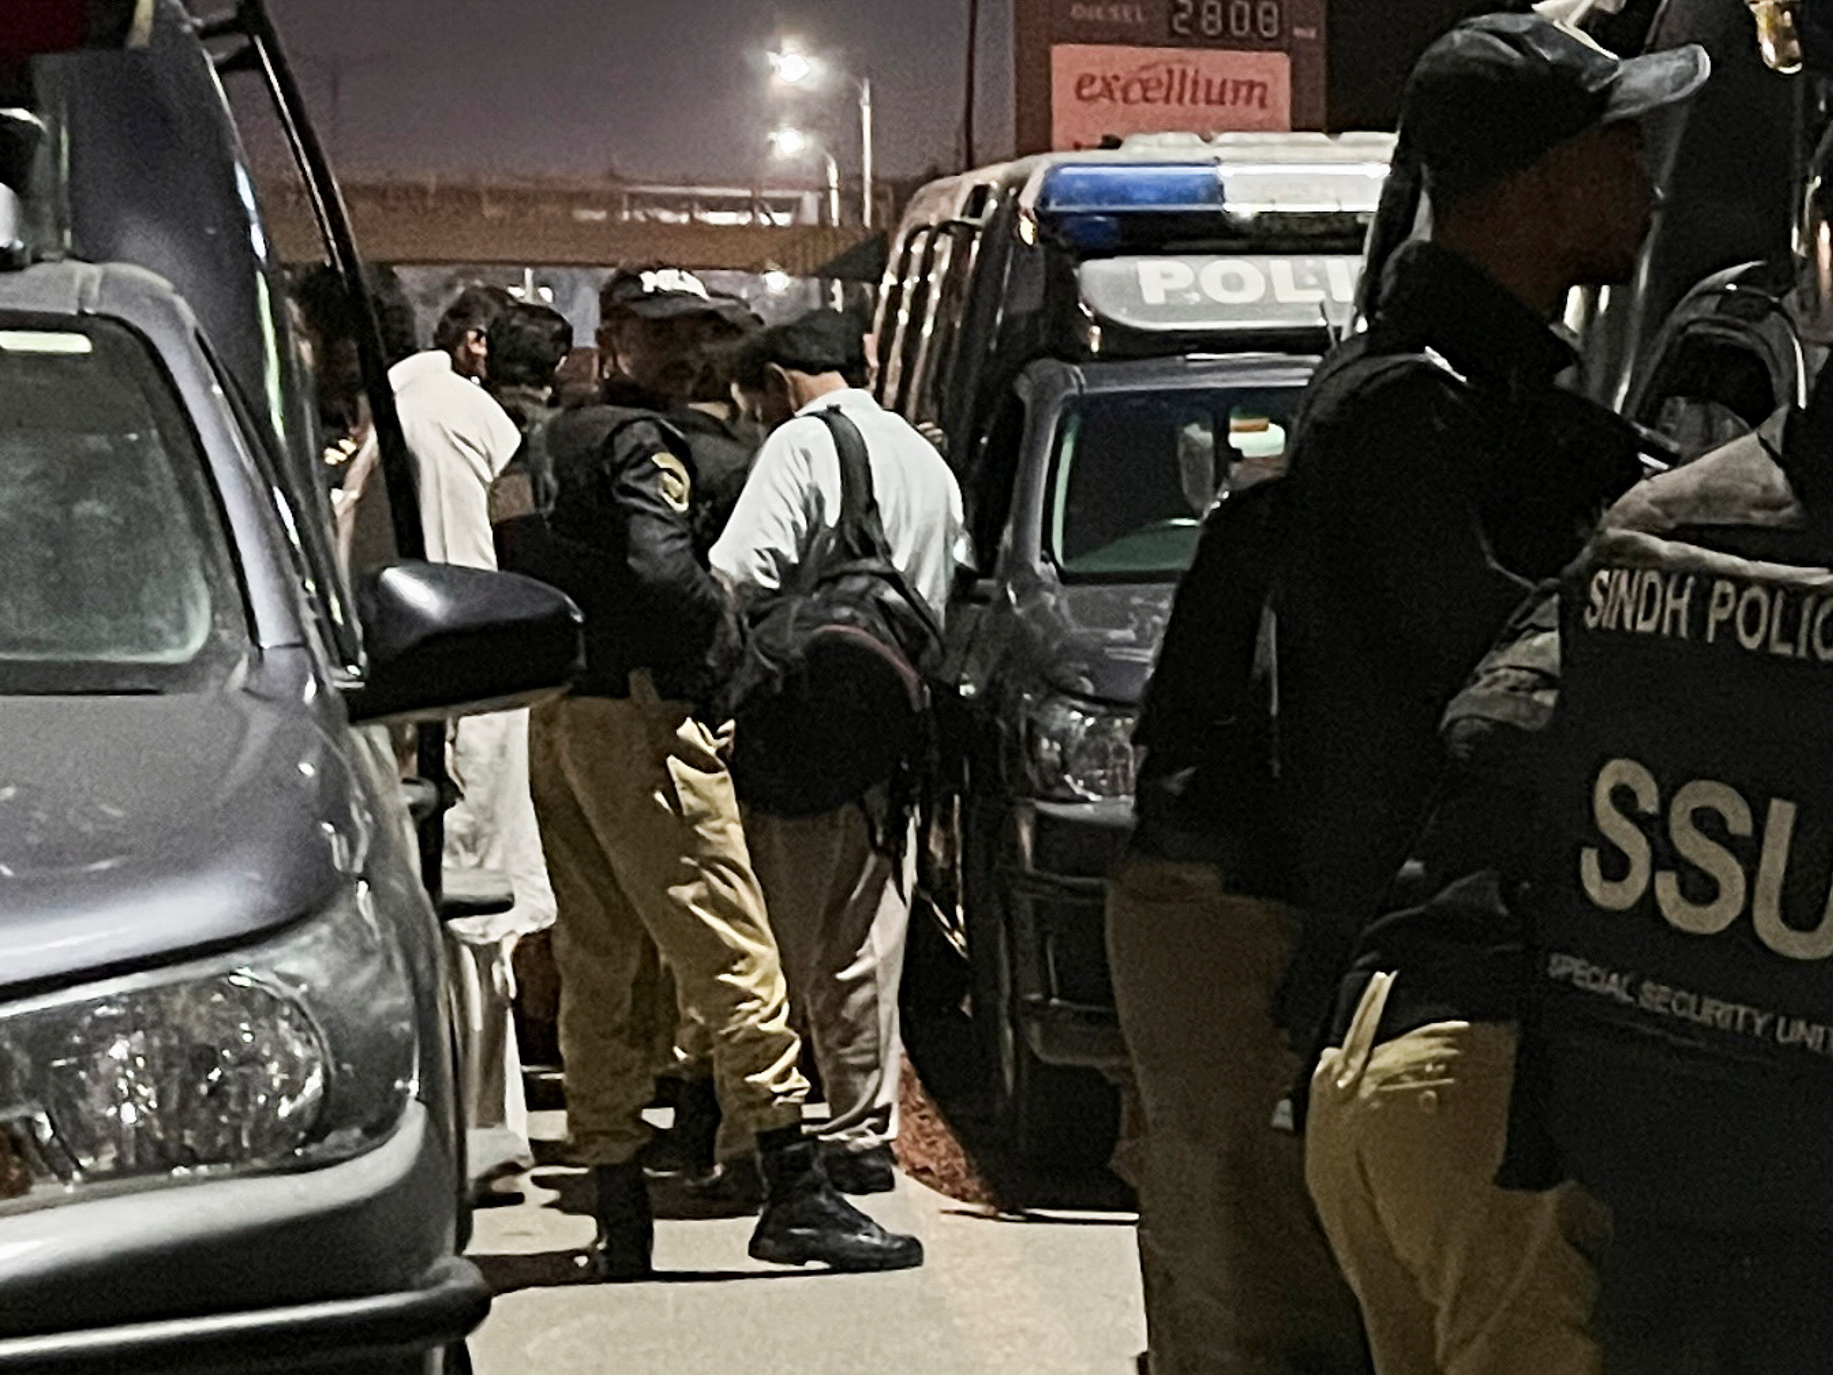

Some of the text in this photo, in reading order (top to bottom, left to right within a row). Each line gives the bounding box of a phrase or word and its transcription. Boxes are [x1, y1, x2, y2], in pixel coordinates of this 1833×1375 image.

[1075, 65, 1269, 109] excellium
[1136, 259, 1354, 305] POLI
[1583, 568, 1690, 639] SINDH
[1548, 952, 1636, 1005] SPECIAL
[1638, 981, 1775, 1041] SECURITY
